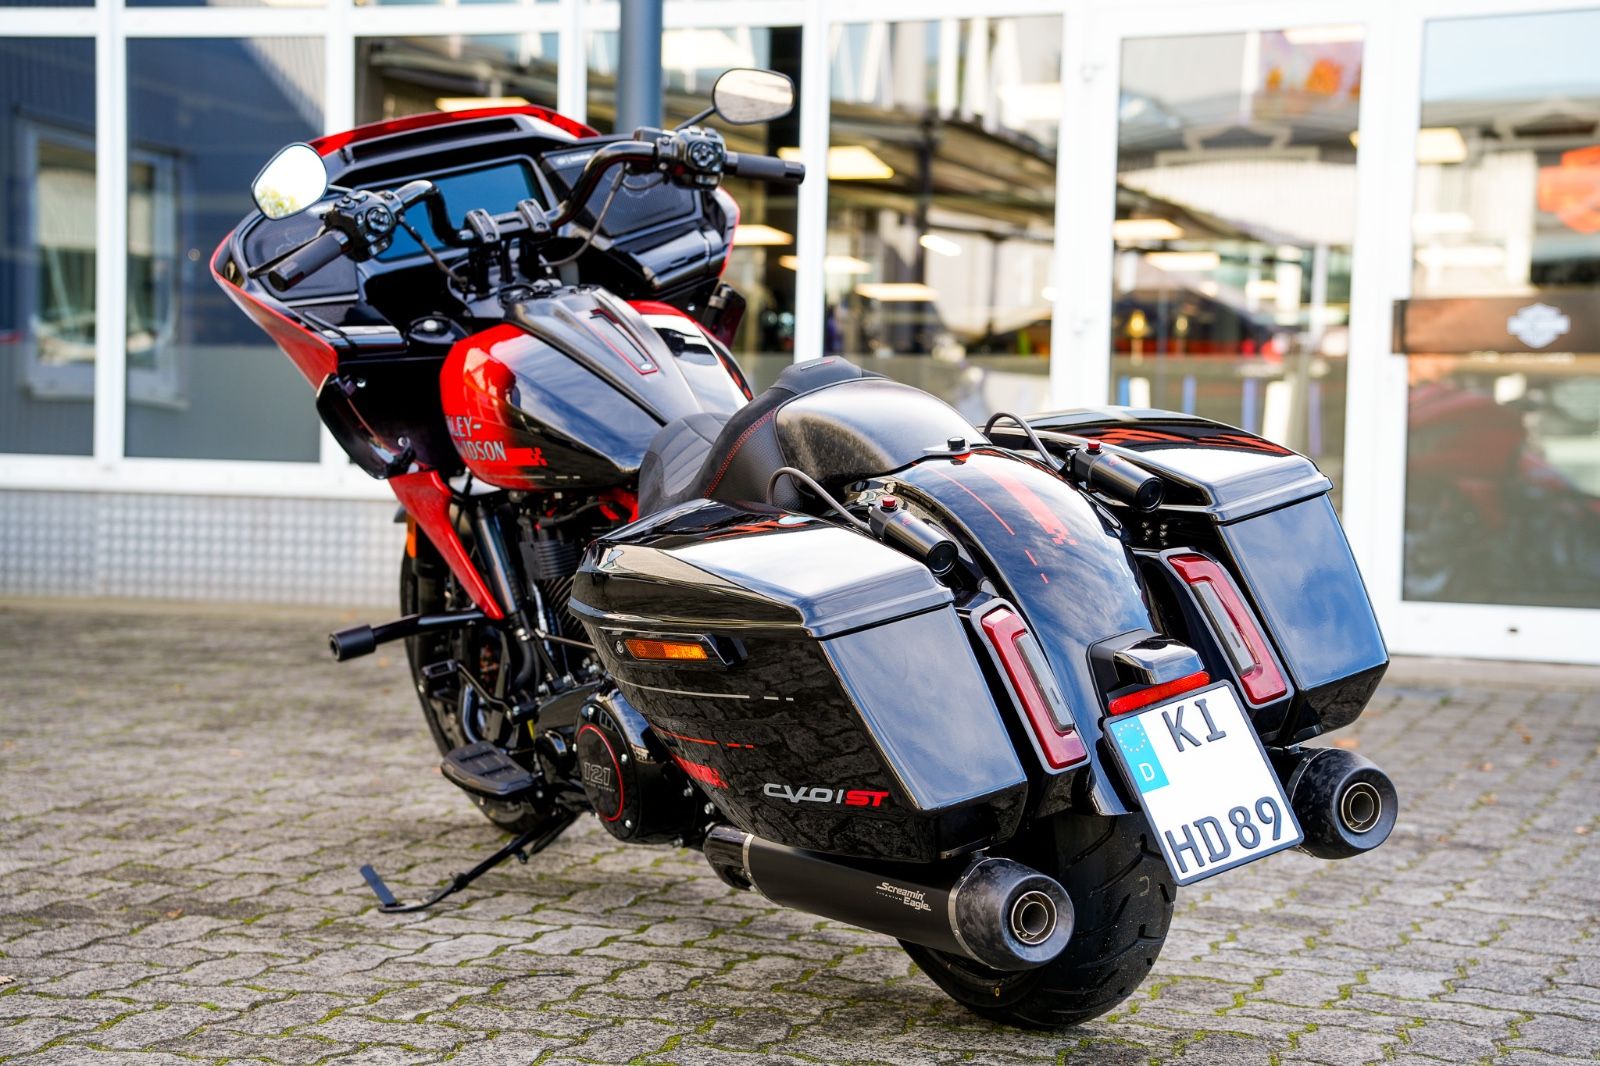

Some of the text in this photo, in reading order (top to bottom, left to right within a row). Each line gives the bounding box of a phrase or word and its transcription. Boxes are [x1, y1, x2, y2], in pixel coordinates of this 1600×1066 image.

[1161, 698, 1226, 752] KI
[583, 761, 611, 786] 121
[1139, 762, 1155, 782] D
[903, 897, 931, 911] Eagle
